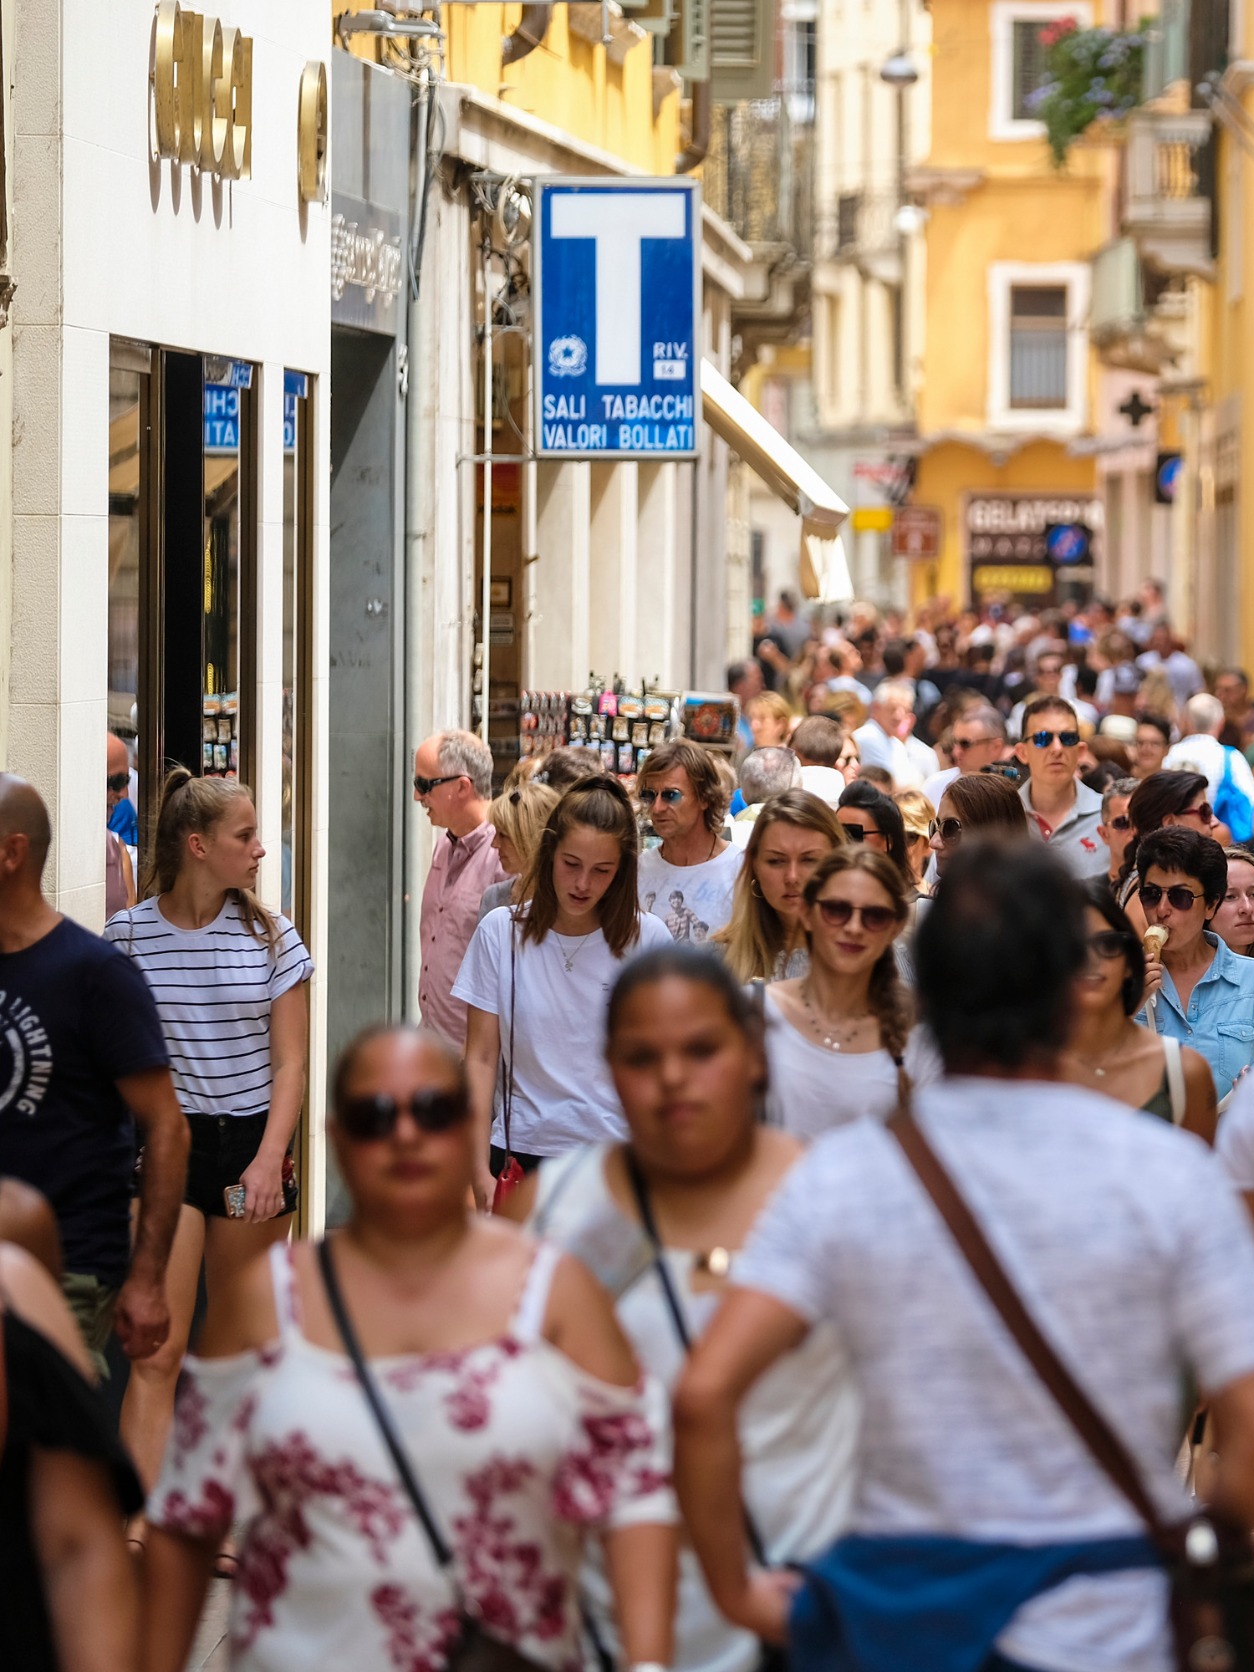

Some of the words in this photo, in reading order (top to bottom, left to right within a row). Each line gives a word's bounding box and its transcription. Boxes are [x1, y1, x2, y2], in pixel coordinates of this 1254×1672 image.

[551, 193, 686, 385] T
[653, 341, 688, 360] RIV.
[544, 395, 586, 420] SALI
[602, 395, 693, 420] TABACCHI
[543, 424, 607, 449] VALORI
[619, 424, 693, 449] BOLLATI
